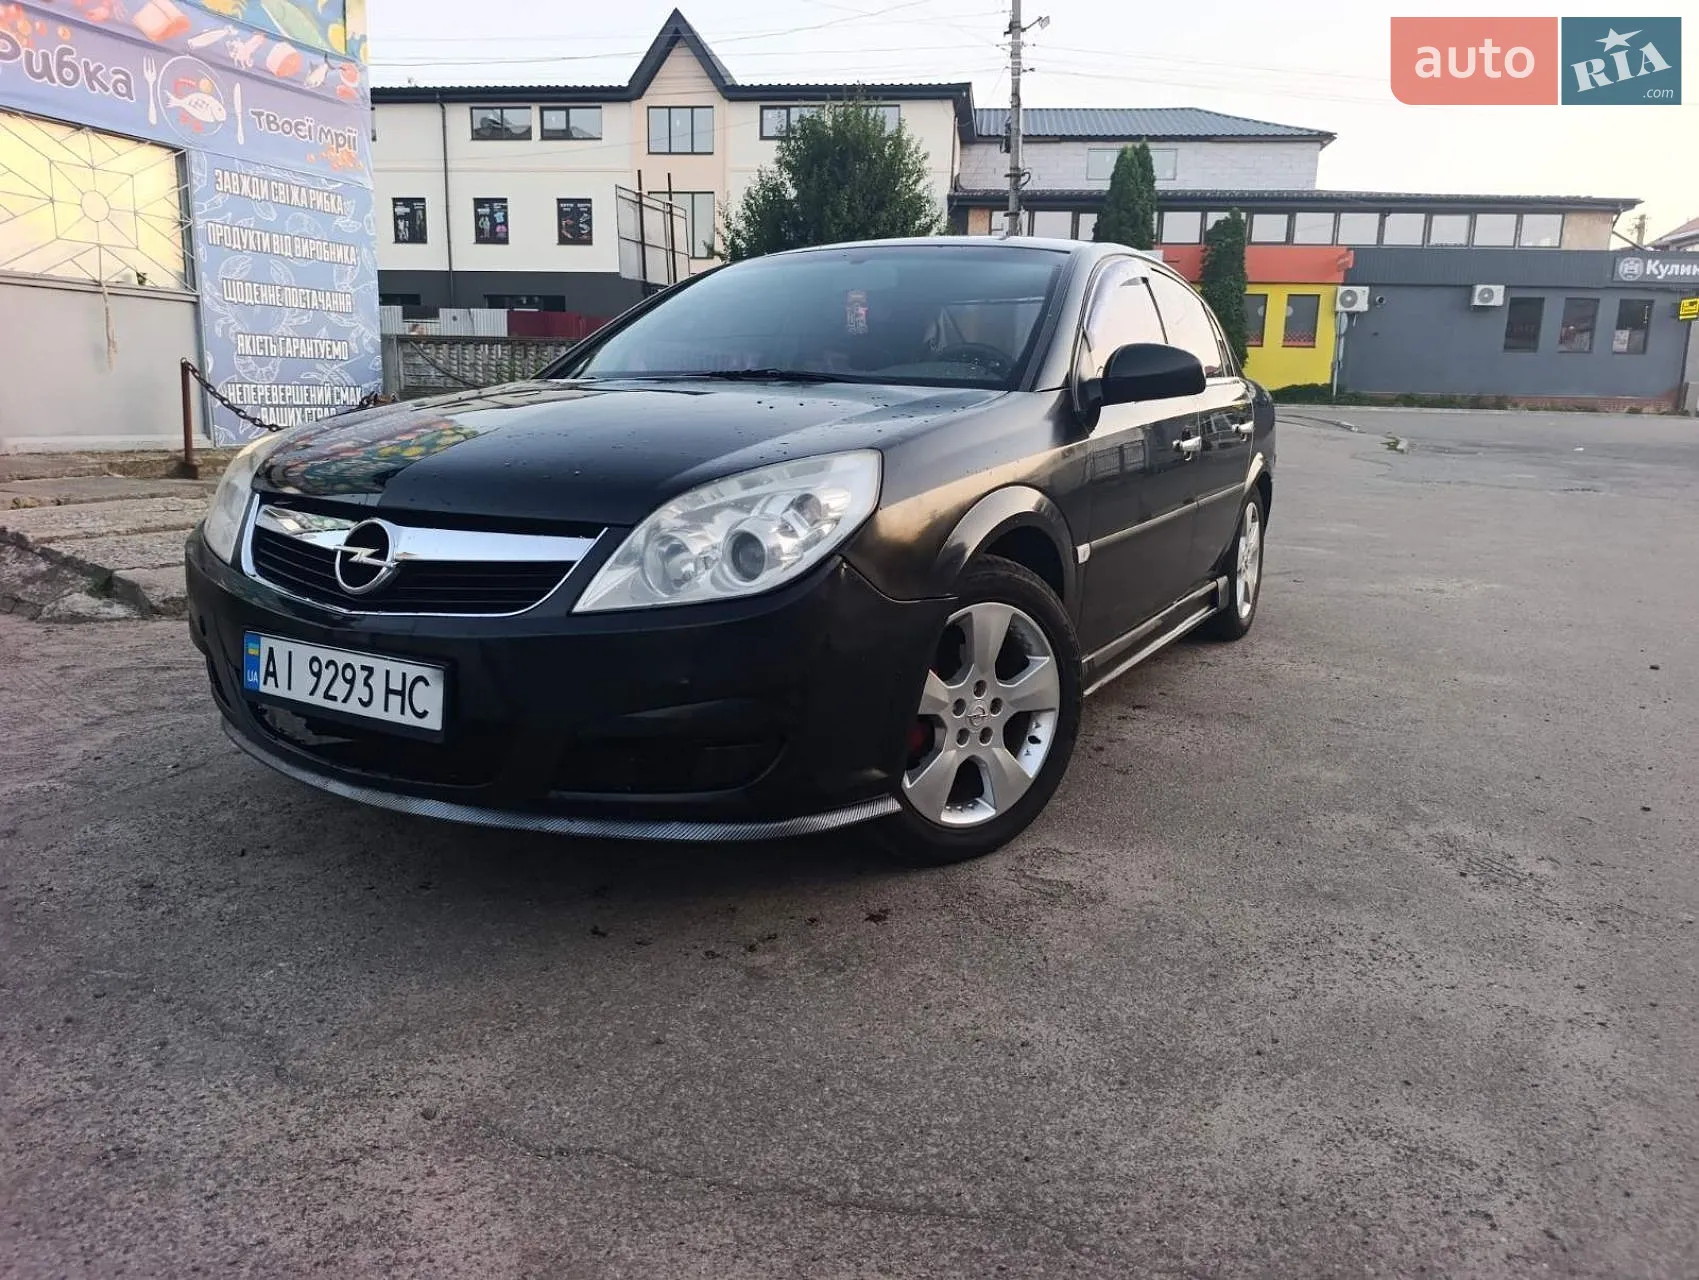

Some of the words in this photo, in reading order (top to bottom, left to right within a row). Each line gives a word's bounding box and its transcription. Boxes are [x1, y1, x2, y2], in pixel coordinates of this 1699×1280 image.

[214, 169, 269, 200] ЗАВЖДИ
[271, 181, 308, 208] СВІЖА
[309, 188, 344, 214] РИБКА
[207, 222, 270, 253] ПРОДУКТИ
[272, 232, 293, 258] ВІД
[294, 237, 357, 266] ВИРОБНИКА
[223, 279, 282, 306] ЩОДЕННЕ
[284, 286, 352, 313] ПОСТАЧАННЯ
[237, 334, 277, 357] ЯКІСТЬ
[227, 382, 331, 405] НЕПЕРЕВЕРШЕНИЙ
[261, 407, 302, 427] ВАШИХ
[247, 669, 259, 684] UA
[263, 647, 293, 691] AI
[307, 656, 375, 708] 9293
[384, 669, 431, 719] HC
